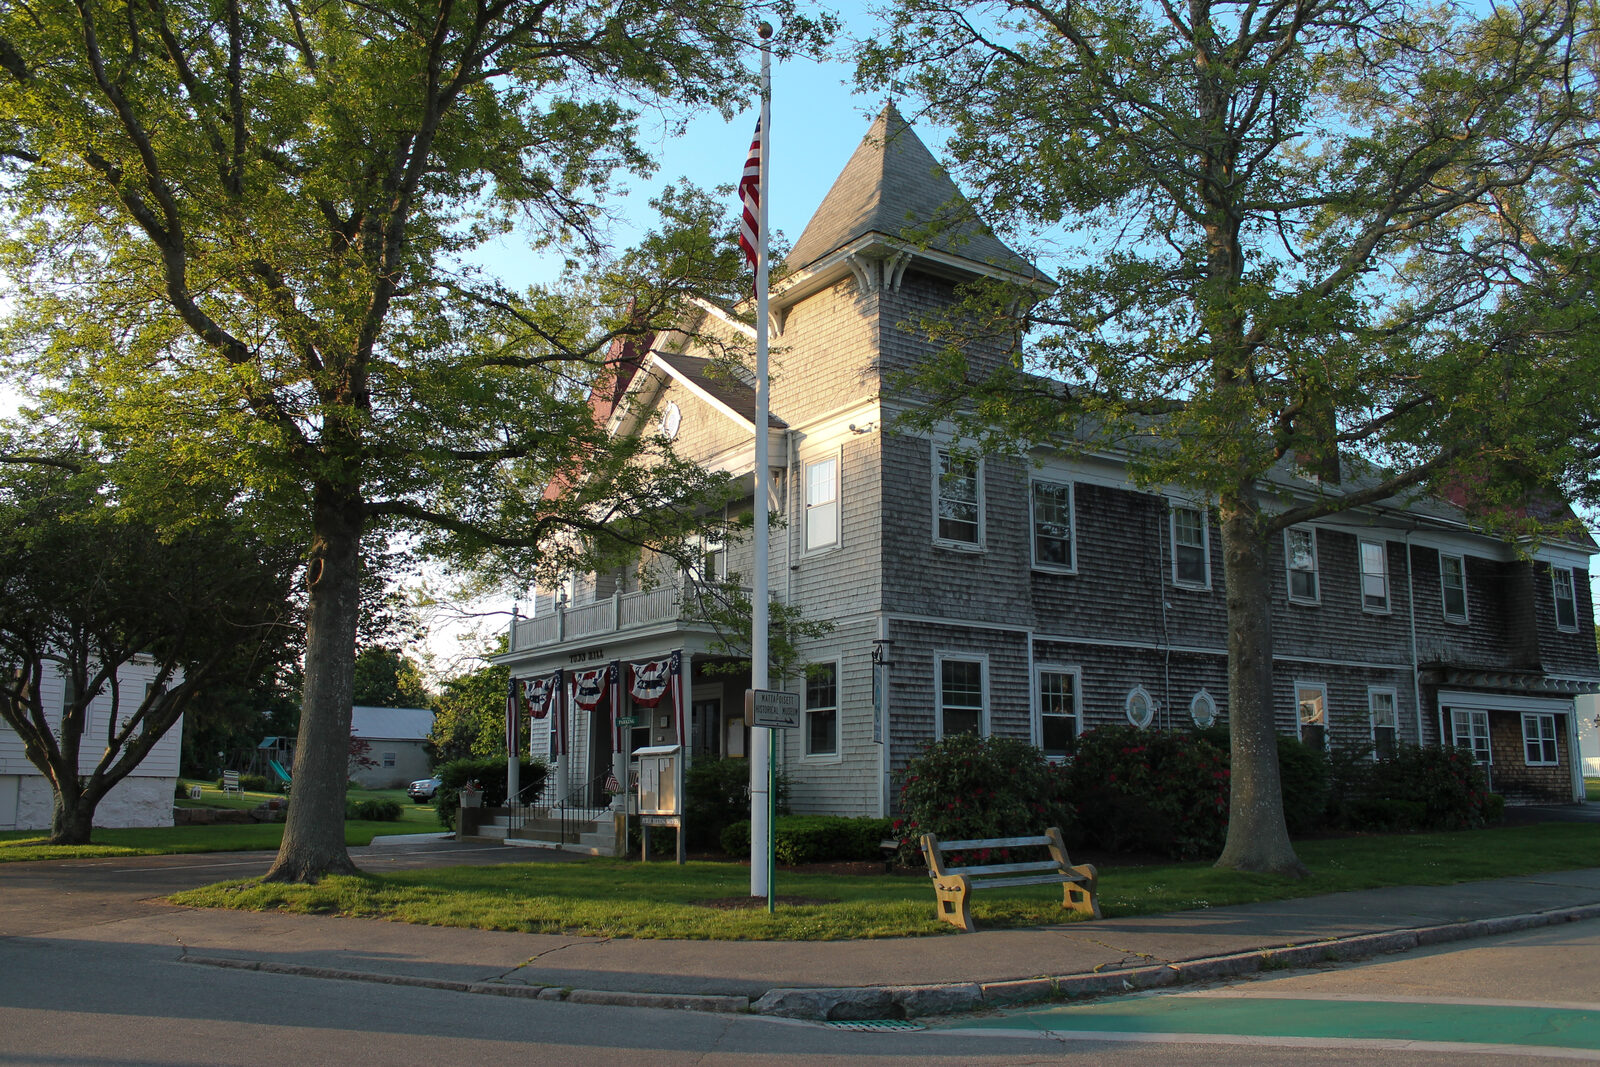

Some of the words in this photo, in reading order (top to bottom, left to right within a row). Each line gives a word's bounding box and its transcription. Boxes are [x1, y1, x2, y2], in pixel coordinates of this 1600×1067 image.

[762, 694, 794, 705] MATTAPOISETT
[756, 704, 779, 715] HISTORICAL
[782, 707, 798, 716] MUSEUM
